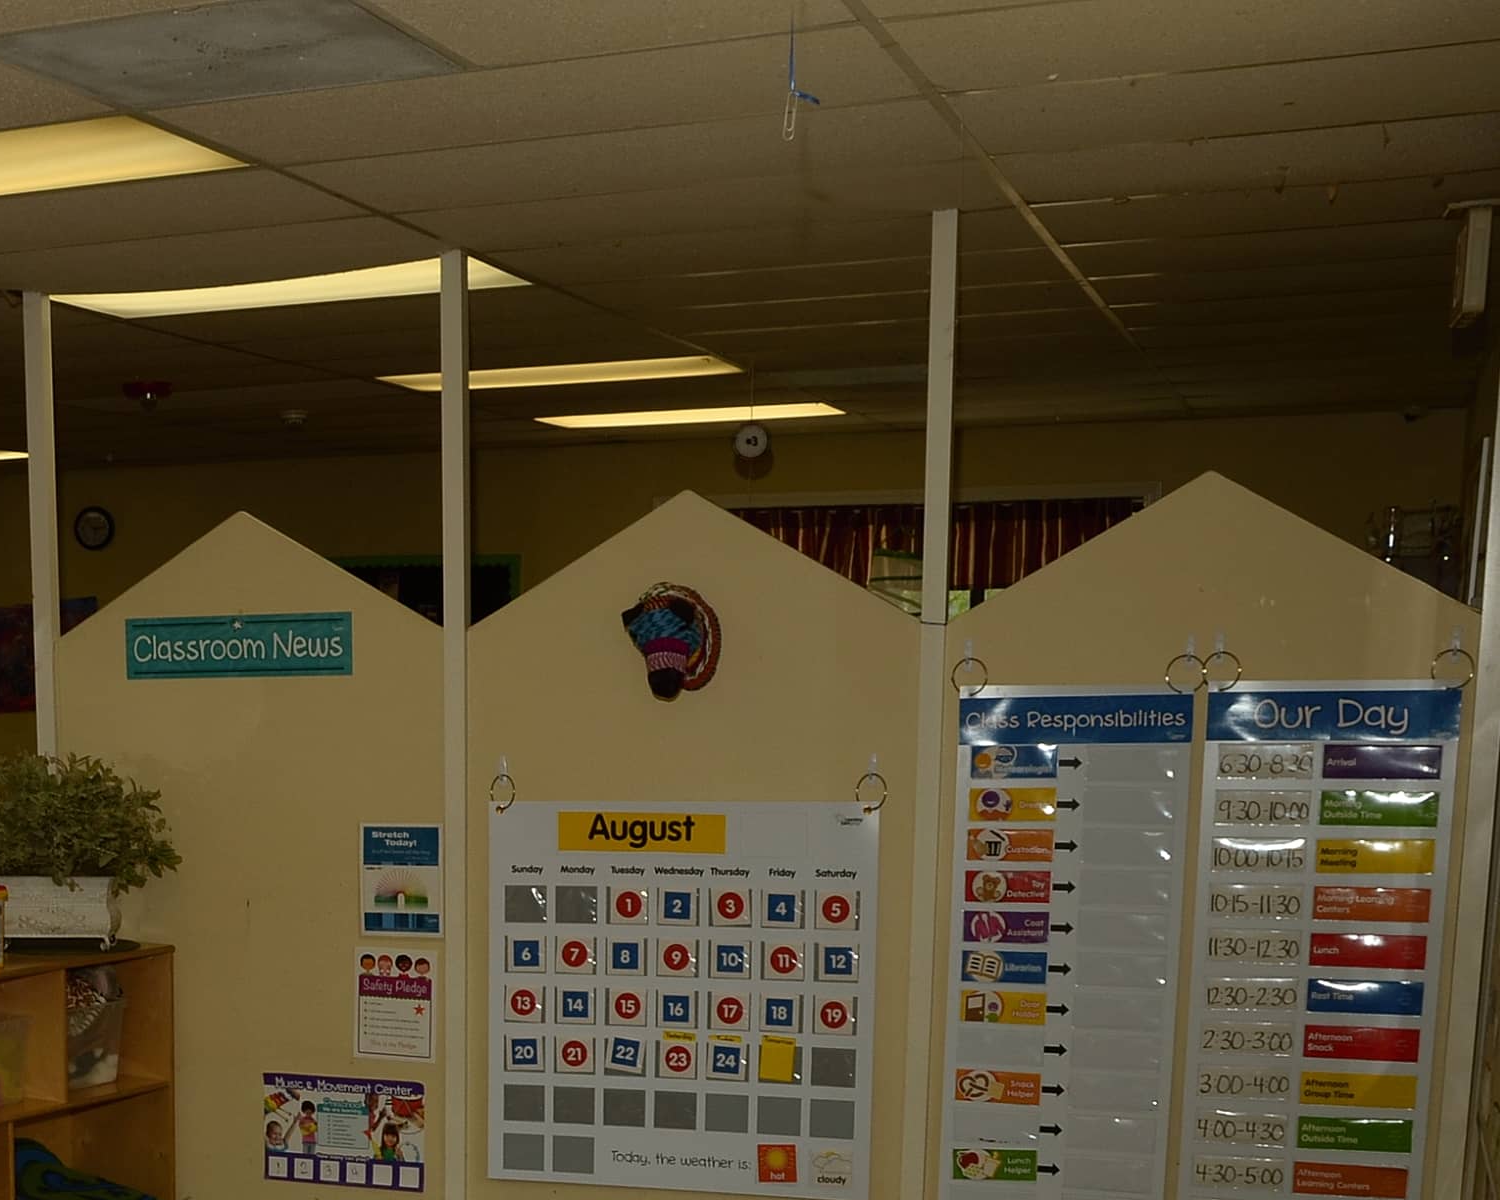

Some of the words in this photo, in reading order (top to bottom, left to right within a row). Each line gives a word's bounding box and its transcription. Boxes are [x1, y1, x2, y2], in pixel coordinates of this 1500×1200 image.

[133, 634, 266, 662] Classroom
[272, 629, 344, 659] News
[965, 711, 1020, 729] Class
[1027, 708, 1187, 732] Responsibilities
[1254, 698, 1322, 729] Our
[1336, 697, 1409, 735] Day
[1325, 757, 1357, 767] Arrival
[1323, 799, 1363, 810] Morning
[1323, 810, 1358, 820] Outside
[1359, 810, 1383, 820] Time
[371, 830, 410, 839] Stretch
[587, 813, 695, 849] August
[383, 839, 418, 848] Today!
[1320, 847, 1358, 858] Morning
[1319, 857, 1357, 868] Meeting
[511, 865, 544, 875] Sunday
[560, 865, 595, 876] Monday
[610, 865, 645, 877] Tuesday
[654, 866, 705, 878] Wednesday
[710, 867, 750, 879] Thursday
[768, 868, 797, 879] Friday
[814, 868, 858, 880] Saturday
[1006, 889, 1045, 899] Detective
[1316, 894, 1354, 905] Morning
[625, 898, 632, 913] 1
[672, 899, 682, 914] 2
[725, 899, 736, 914] 3
[775, 901, 788, 916] 4
[830, 902, 841, 918] 5
[1316, 904, 1351, 914] Centers
[1023, 919, 1045, 927] Coat
[1006, 928, 1044, 938] Assistant
[1312, 945, 1340, 955] Lunch
[521, 947, 532, 961] 6
[570, 947, 580, 962] 7
[620, 949, 630, 964] 8
[671, 950, 682, 965] 9
[721, 952, 739, 967] 10
[777, 954, 790, 967] 11
[829, 954, 847, 969] 12
[1004, 963, 1042, 973] Librarian
[363, 977, 393, 995] Safety
[395, 980, 428, 997] Pledge
[1311, 991, 1331, 1001] Rest
[1332, 992, 1354, 1002] Time
[515, 995, 531, 1010] 13
[566, 998, 584, 1012] 14
[619, 999, 636, 1014] 15
[668, 1002, 684, 1017] 16
[722, 1004, 738, 1018] 17
[771, 1005, 788, 1021] 18
[825, 1008, 843, 1023] 19
[1307, 1032, 1354, 1043] Afternoon
[1306, 1043, 1335, 1053] Snack
[514, 1045, 535, 1059] 20
[566, 1047, 582, 1061] 21
[615, 1044, 636, 1061] 22
[668, 1052, 689, 1067] 23
[716, 1053, 737, 1068] 24
[274, 1076, 304, 1090] Music
[316, 1079, 372, 1095] Movement
[374, 1083, 413, 1097] Center
[1010, 1079, 1035, 1089] Snack
[1304, 1078, 1350, 1089] Afternoon
[1006, 1089, 1035, 1099] Helper
[1303, 1089, 1332, 1100] Group
[1333, 1090, 1355, 1100] Time
[1301, 1123, 1347, 1134] Afternoon
[1300, 1133, 1335, 1144] Outside
[1336, 1135, 1359, 1145] Time
[610, 1150, 651, 1167] Today,
[655, 1153, 676, 1166] the
[680, 1154, 733, 1169] weather
[1007, 1157, 1032, 1166] Lunch
[769, 1170, 786, 1181] hot
[1003, 1166, 1032, 1176] Helper
[1297, 1168, 1343, 1179] Afternoon
[817, 1175, 847, 1186] cloudy
[1296, 1178, 1335, 1190] Learning
[1336, 1181, 1371, 1191] Centers
